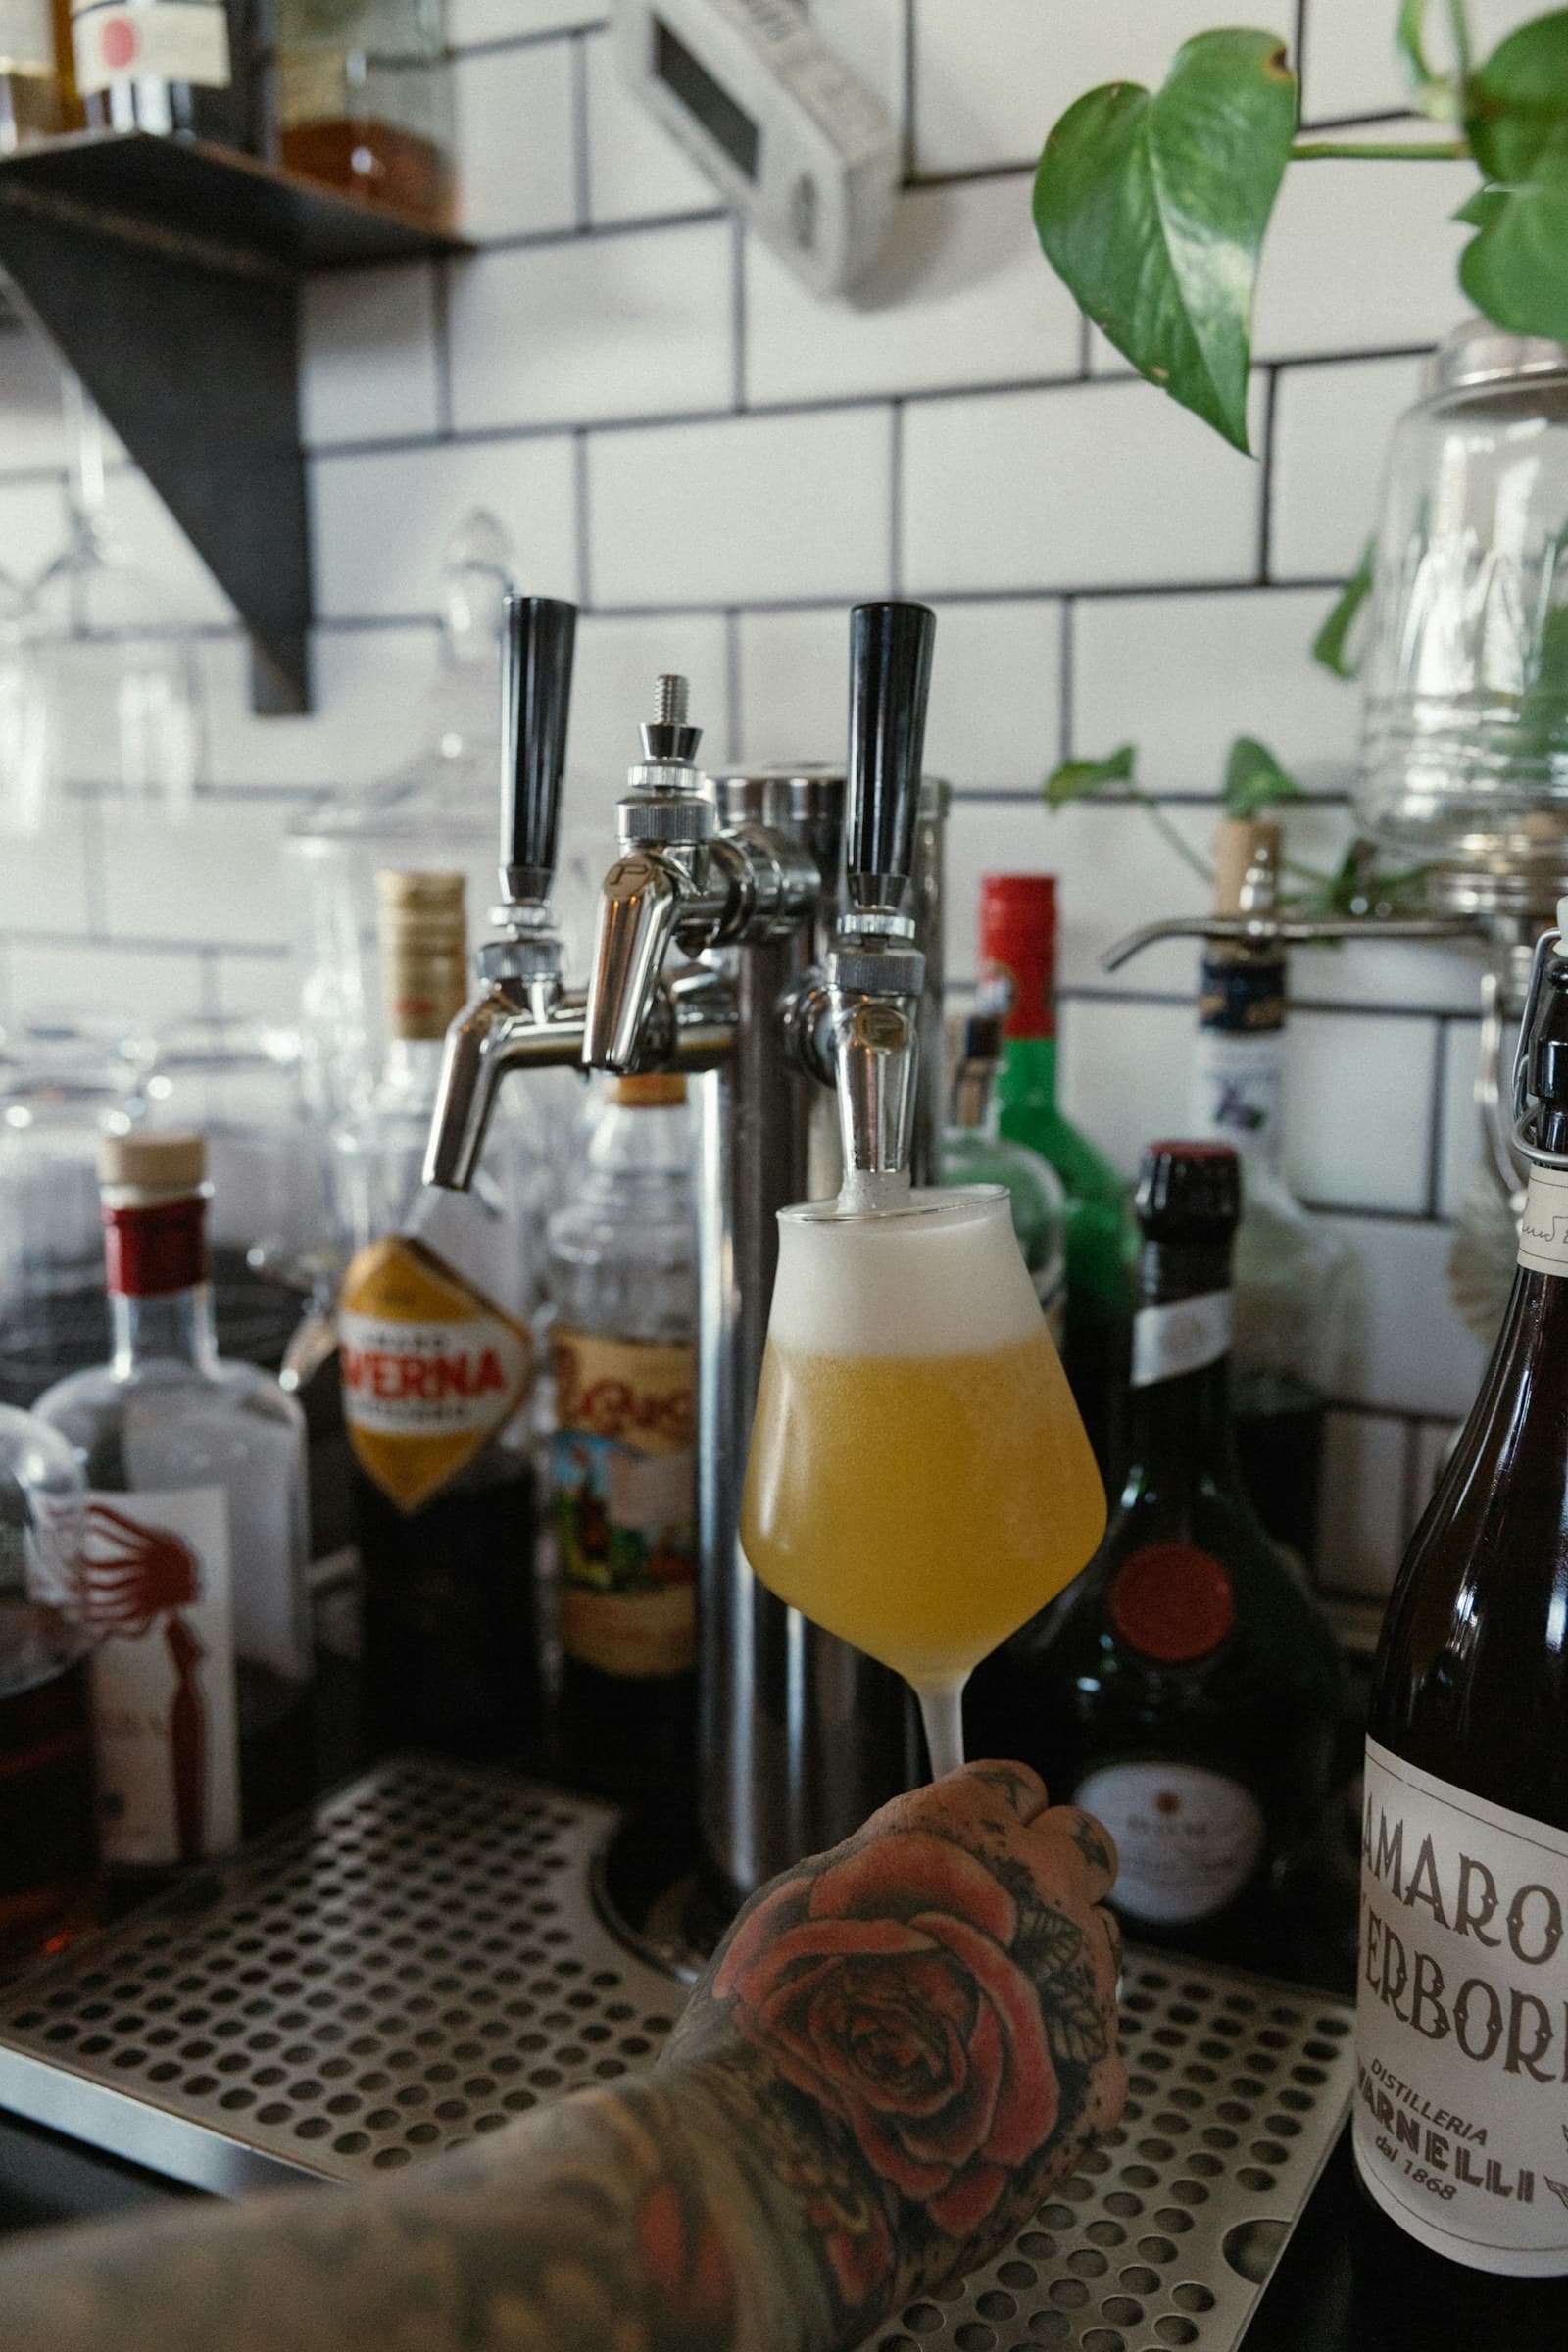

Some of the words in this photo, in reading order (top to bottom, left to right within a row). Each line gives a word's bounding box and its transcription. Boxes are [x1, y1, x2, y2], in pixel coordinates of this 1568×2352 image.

[1362, 1791, 1563, 1965] AMARO
[1371, 2058, 1489, 2146] DISTILLERIA
[1375, 2135, 1399, 2163] dal
[1402, 2159, 1457, 2201] 1868
